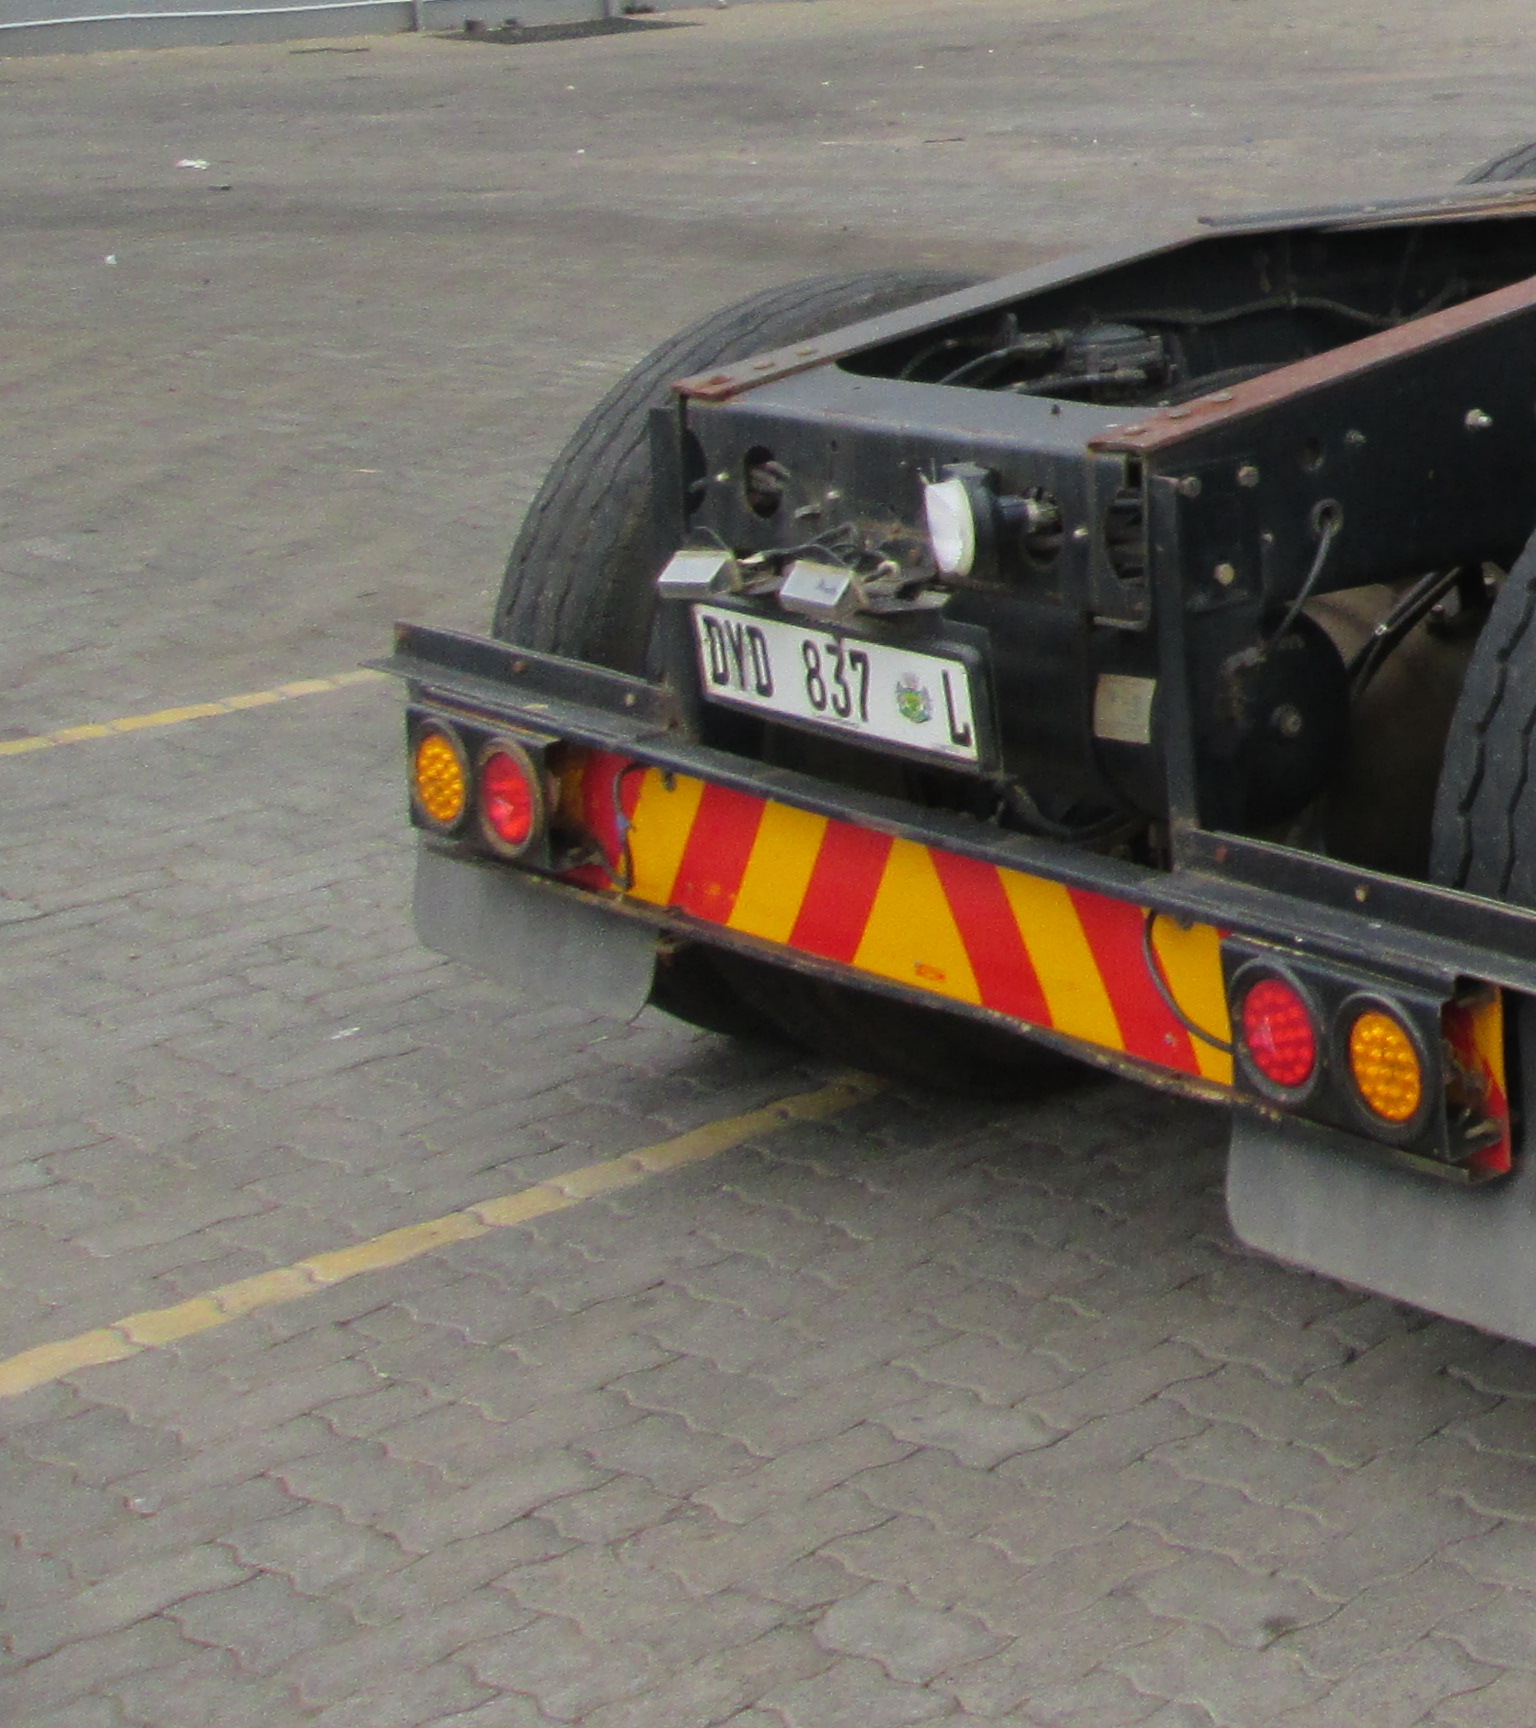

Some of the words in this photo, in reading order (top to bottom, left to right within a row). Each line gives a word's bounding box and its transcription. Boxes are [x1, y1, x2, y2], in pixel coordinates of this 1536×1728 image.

[702, 614, 775, 698] DYD
[801, 636, 871, 723] 837
[941, 668, 973, 747] L
